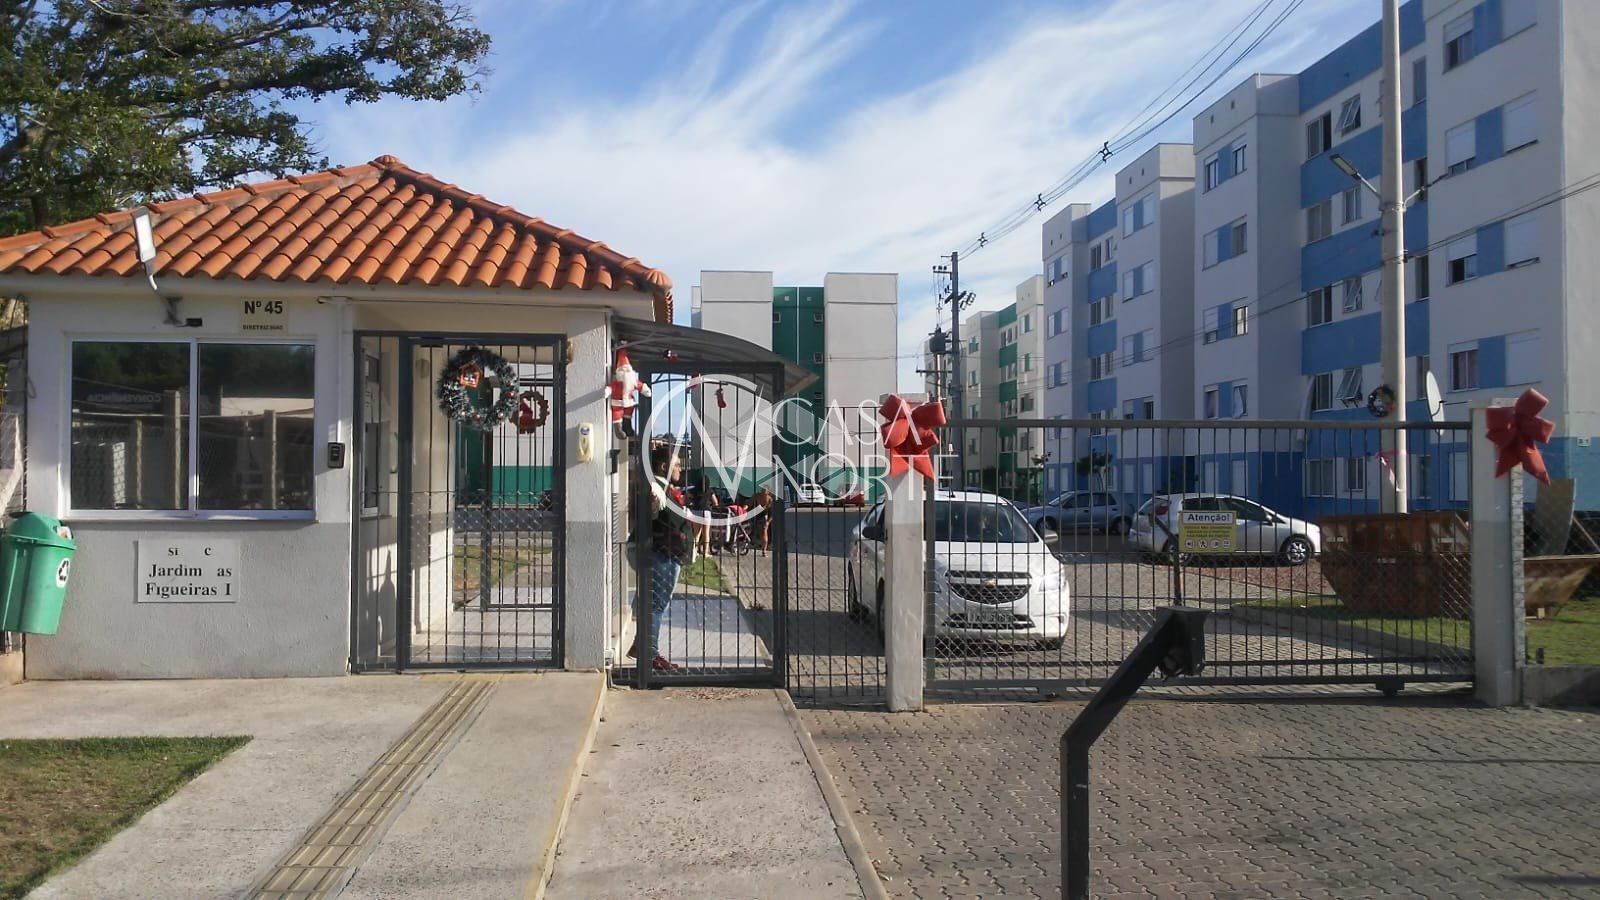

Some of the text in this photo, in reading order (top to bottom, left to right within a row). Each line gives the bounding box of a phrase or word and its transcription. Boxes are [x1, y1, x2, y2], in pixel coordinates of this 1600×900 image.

[264, 300, 283, 315] 45
[1188, 513, 1230, 523] Atenção!
[149, 563, 202, 578] Jardim
[146, 582, 232, 599] Figueiras I
